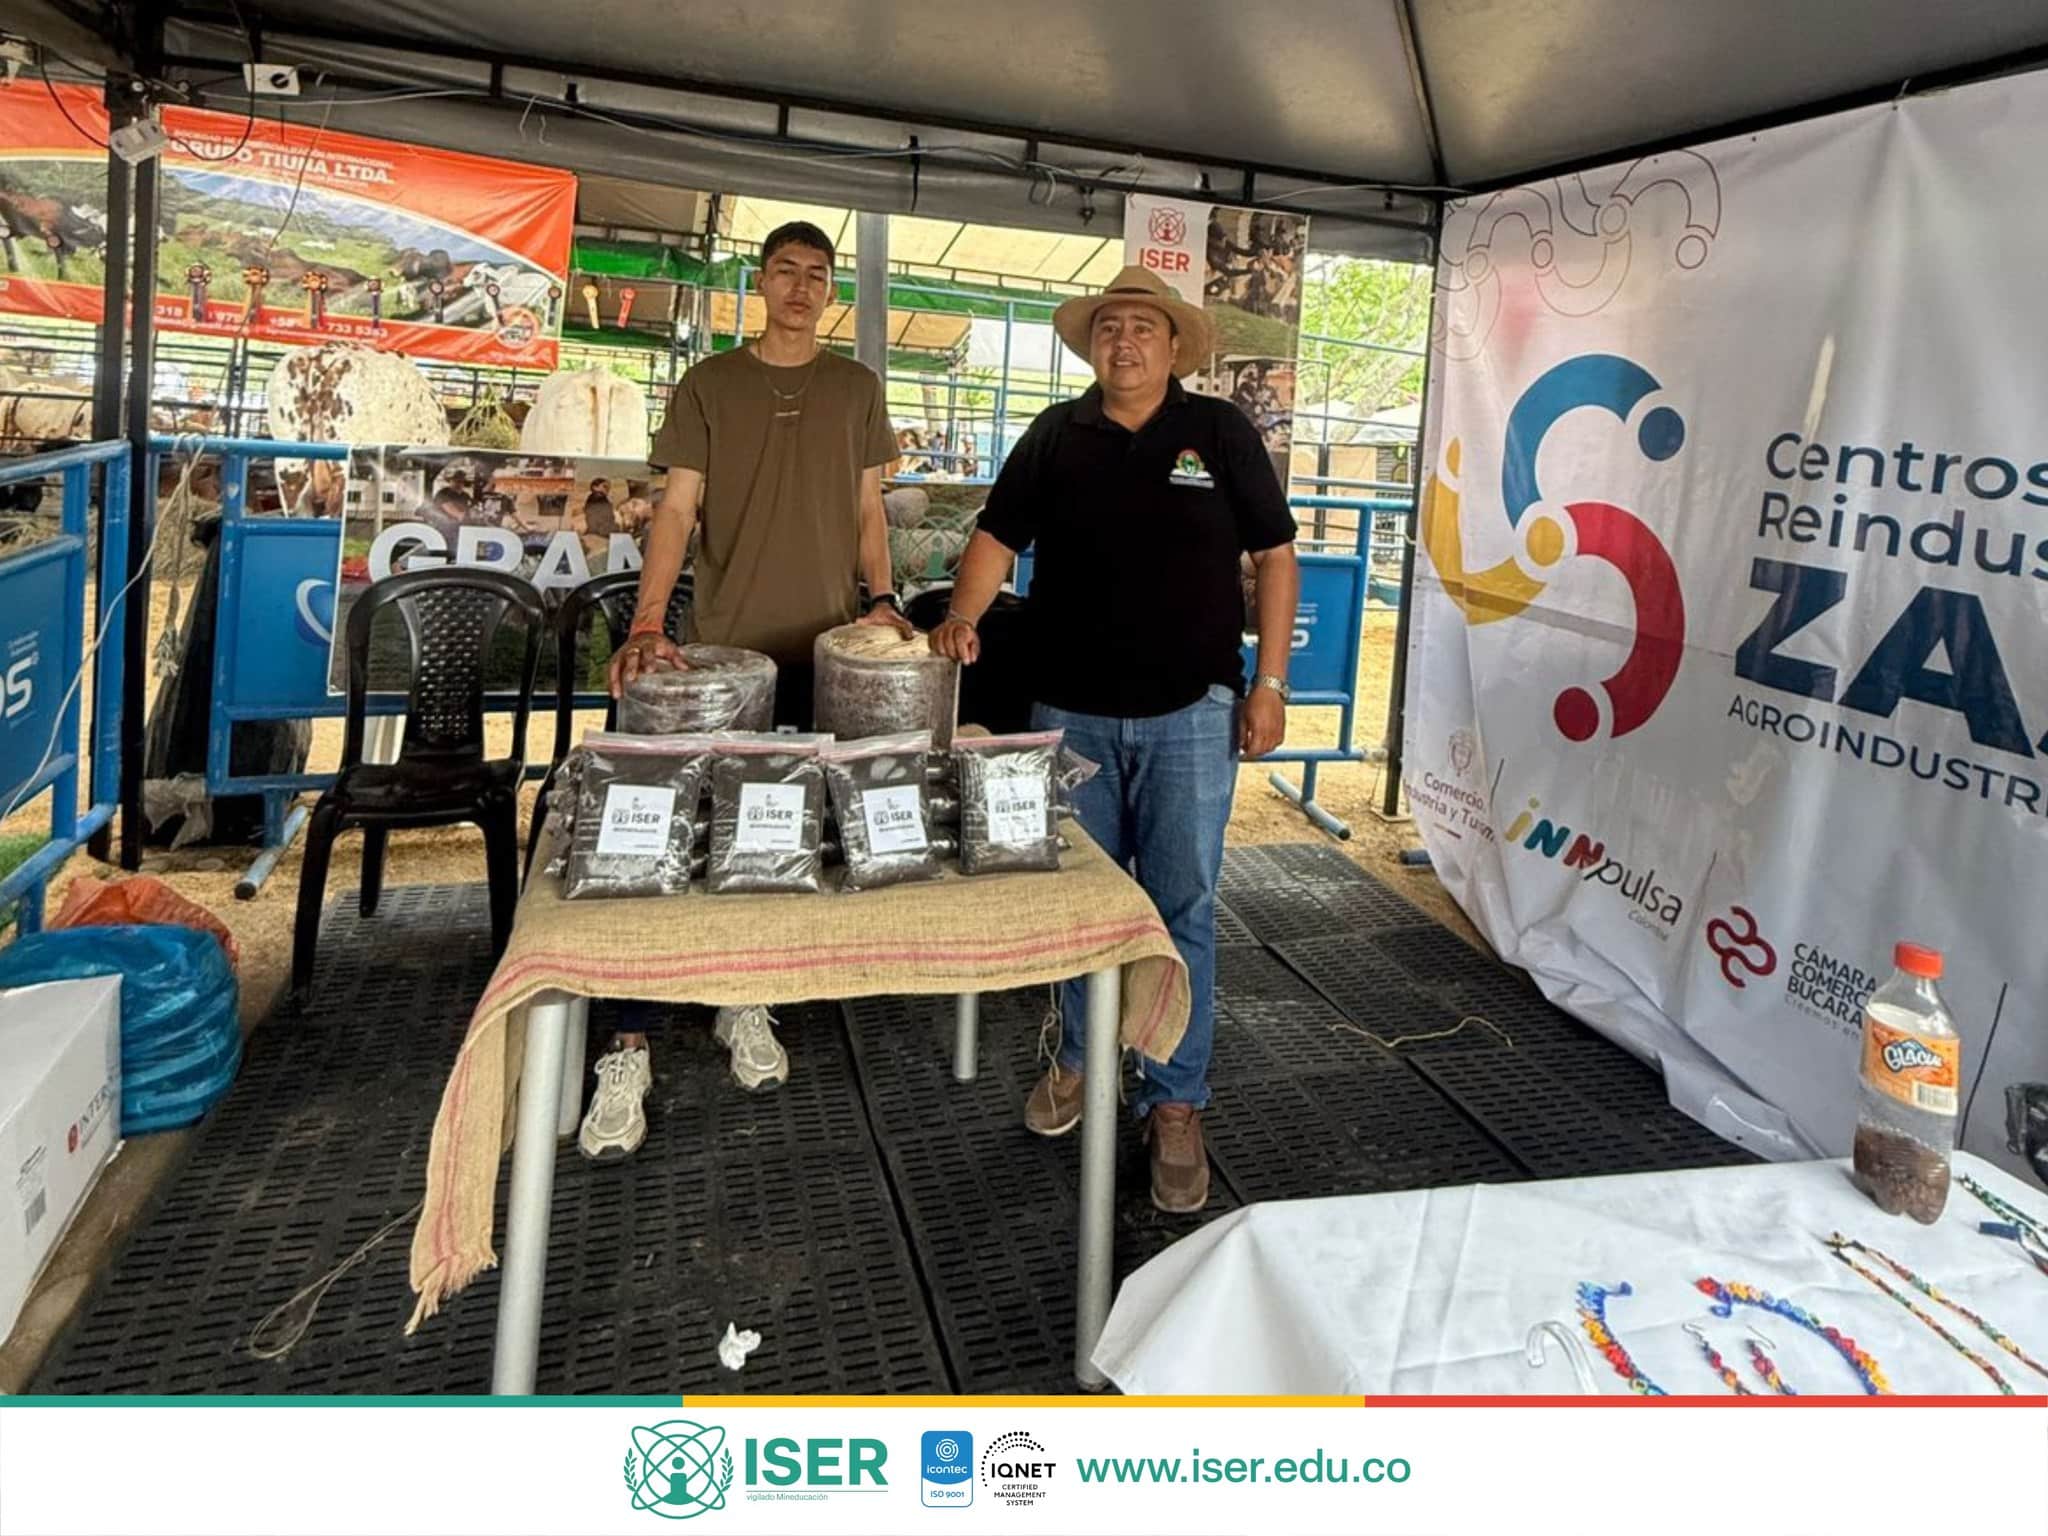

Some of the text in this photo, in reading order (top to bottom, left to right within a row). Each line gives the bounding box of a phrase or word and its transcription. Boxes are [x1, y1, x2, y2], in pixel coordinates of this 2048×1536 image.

[171, 139, 254, 162] GRUPO
[1139, 247, 1190, 272] ISER
[1766, 432, 2048, 506] Centros
[1735, 557, 2048, 760] ZA
[631, 812, 661, 825] ISER
[766, 809, 793, 820] ISER
[1791, 960, 1868, 1010] COMERC
[1794, 943, 1877, 993] CÁMARA
[1787, 975, 1863, 1030] BUCARA
